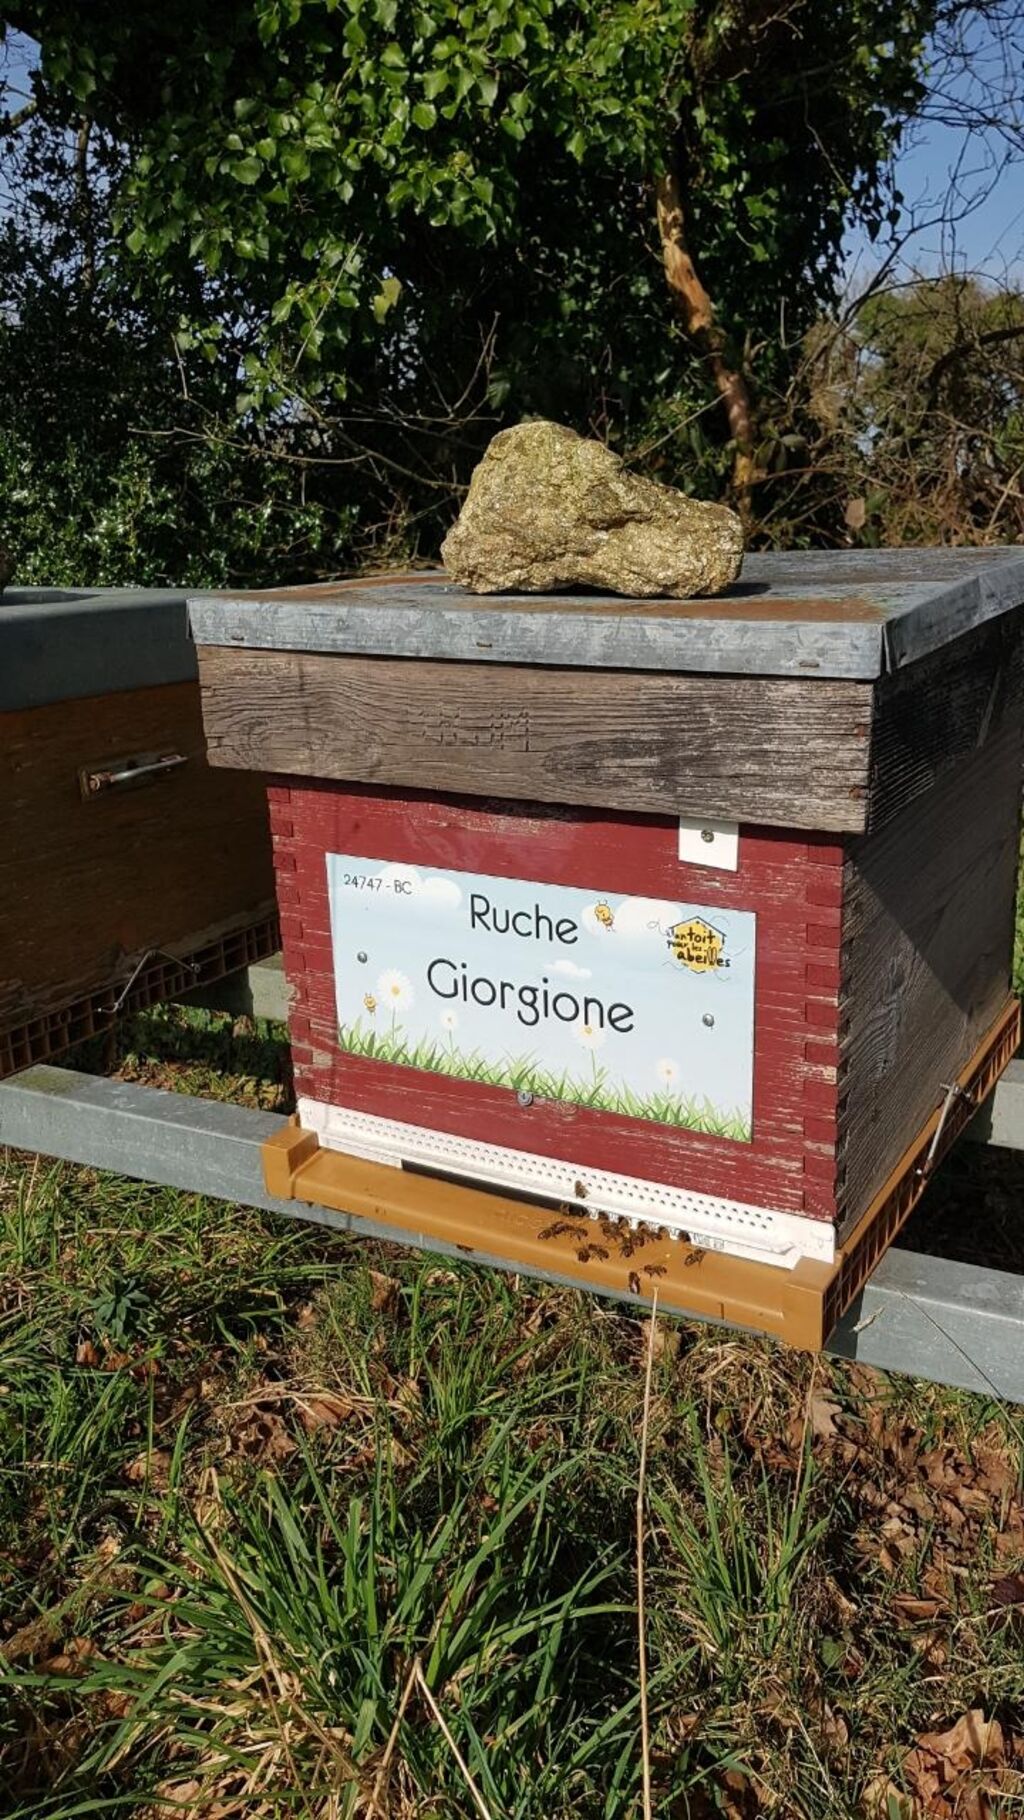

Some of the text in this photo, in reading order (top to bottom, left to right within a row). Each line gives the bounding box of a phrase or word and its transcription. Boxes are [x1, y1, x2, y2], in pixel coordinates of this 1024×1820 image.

[470, 893, 578, 945] Ruche
[687, 927, 716, 944] toit
[677, 946, 731, 968] abeilles
[427, 958, 634, 1033] Giorgione
